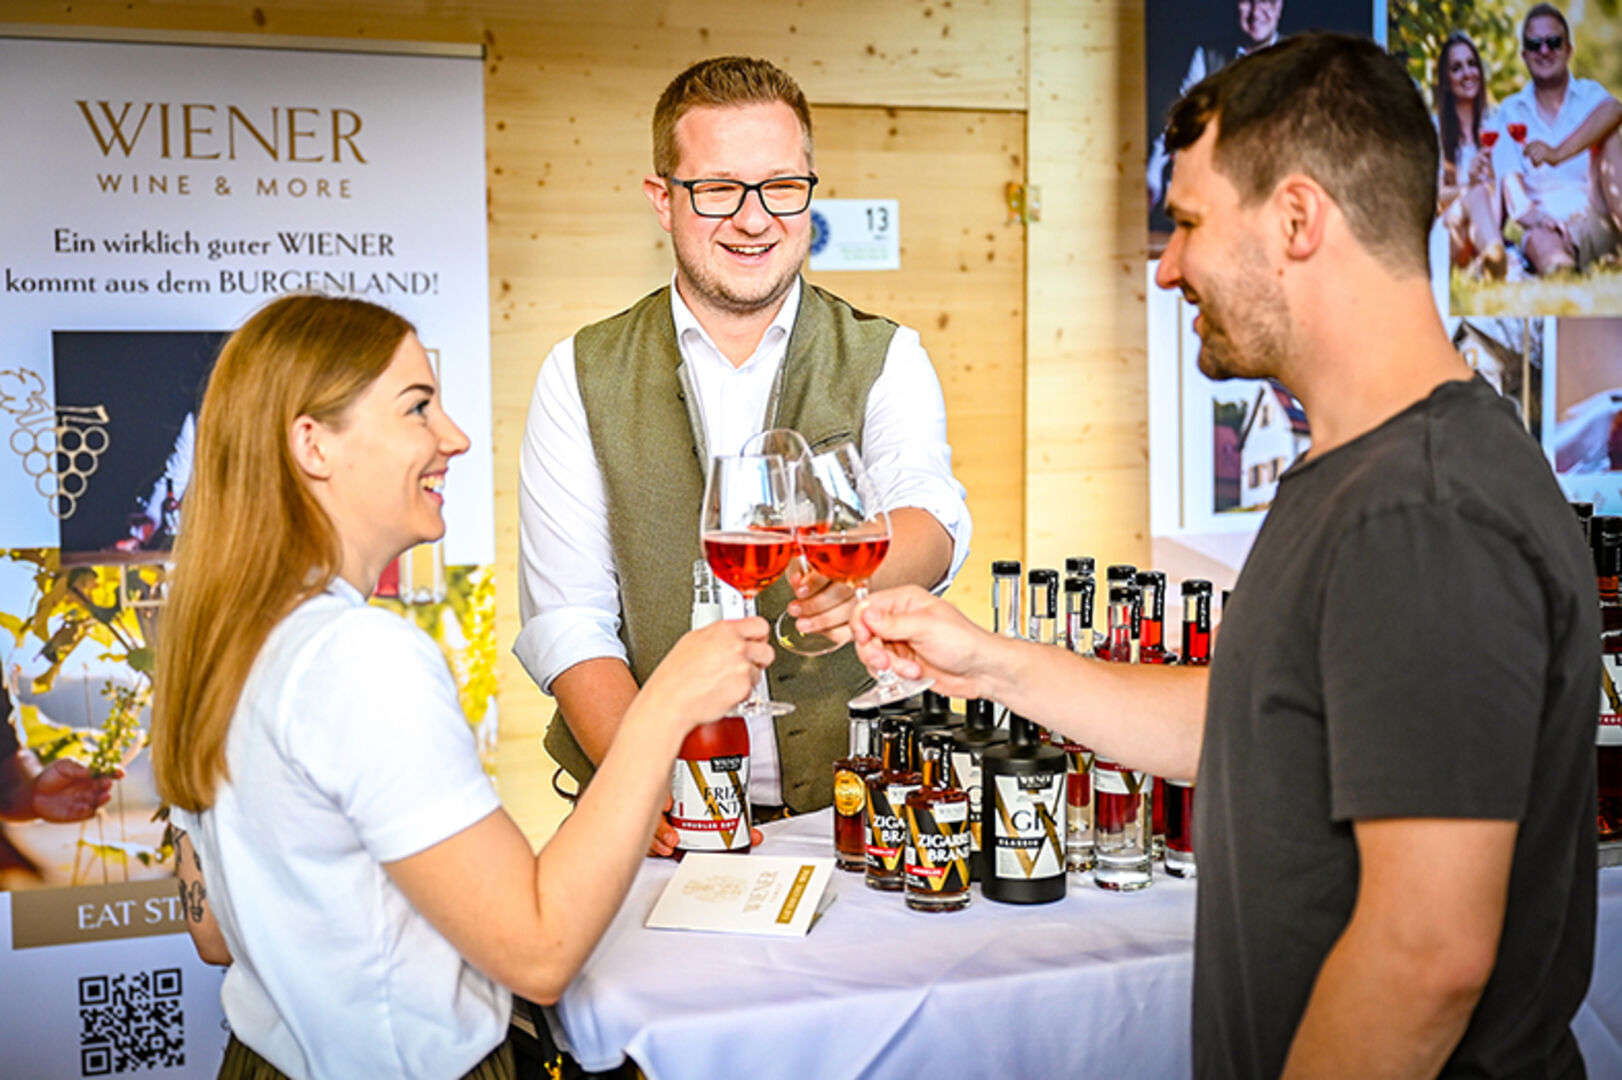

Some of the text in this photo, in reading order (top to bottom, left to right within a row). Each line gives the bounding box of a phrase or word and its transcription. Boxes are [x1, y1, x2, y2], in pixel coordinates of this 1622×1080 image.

[76, 99, 369, 165] WIENER
[97, 174, 353, 198] WINE & MORE
[866, 206, 889, 231] 13
[54, 228, 394, 260] Ein wirklich guter WIENER
[6, 268, 439, 295] kommt aus dem BURGENLAND!
[78, 900, 137, 929] EAT
